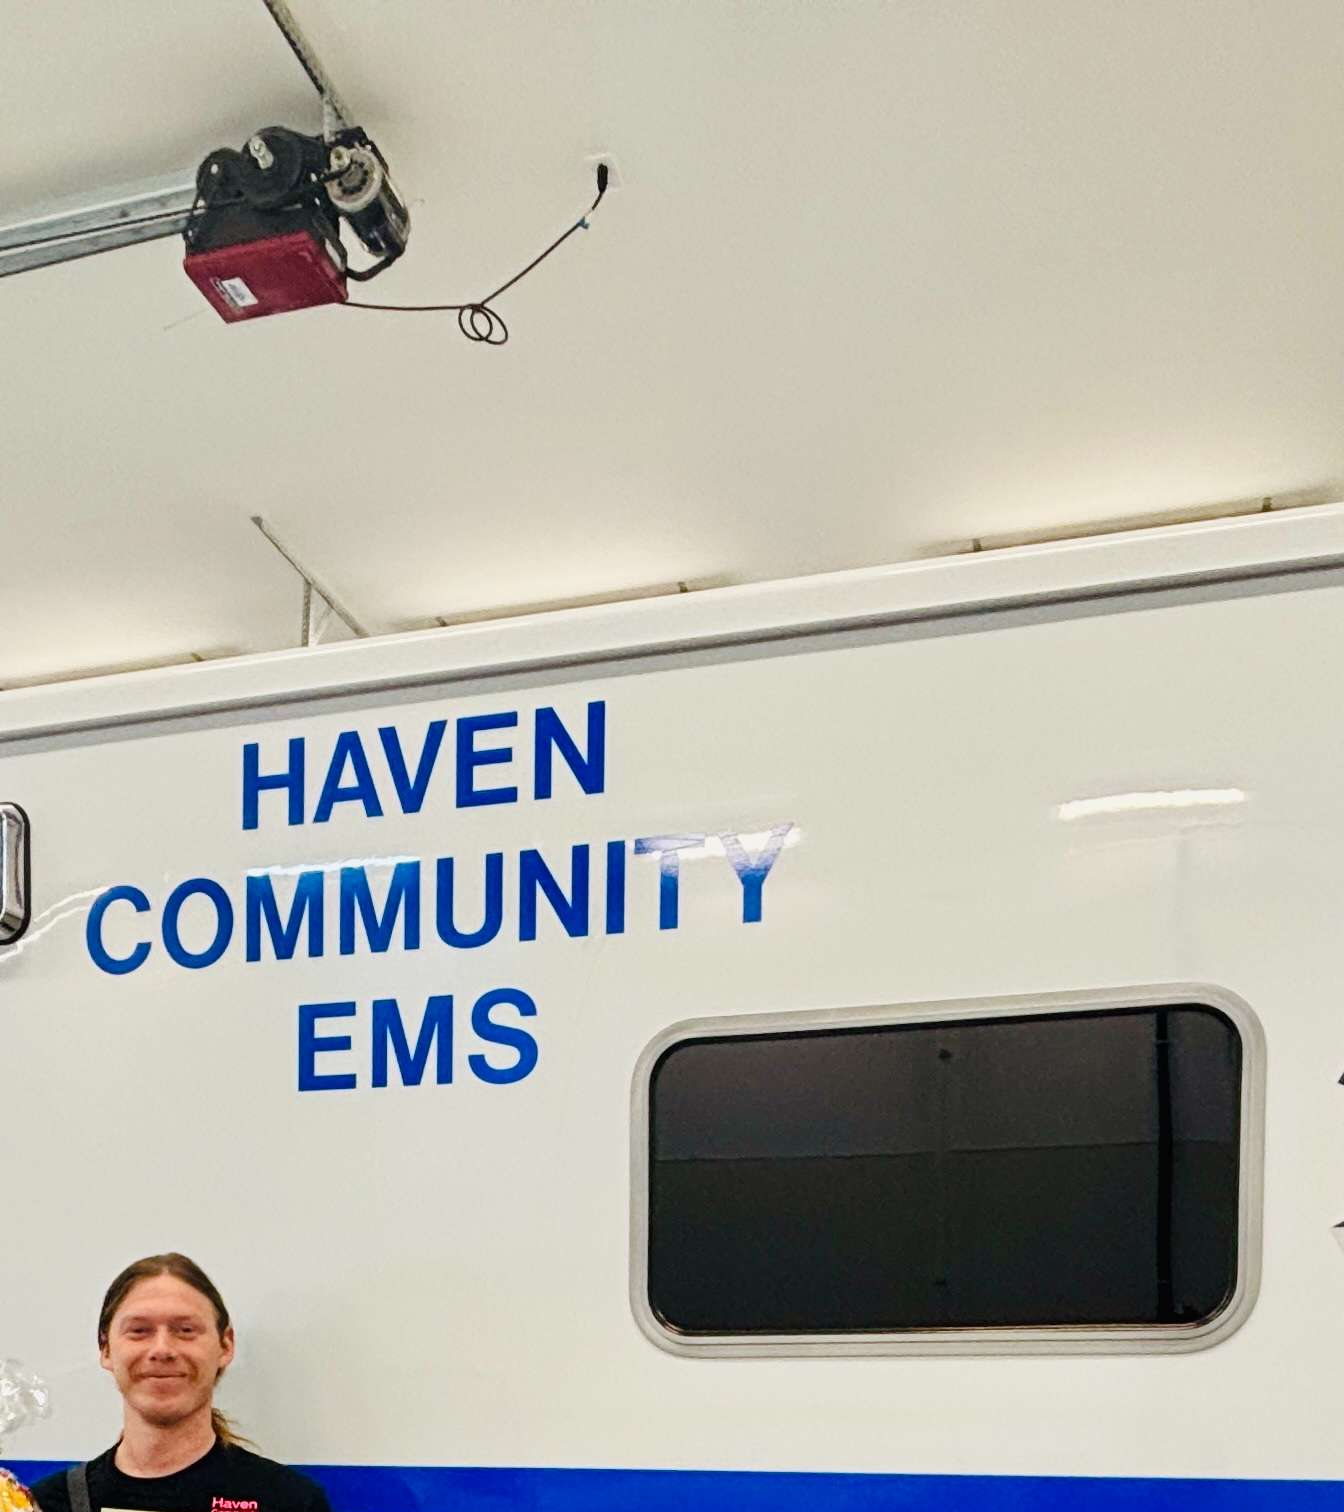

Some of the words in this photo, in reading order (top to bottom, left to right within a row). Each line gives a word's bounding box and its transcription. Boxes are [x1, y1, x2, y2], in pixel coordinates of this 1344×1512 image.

[242, 700, 607, 830] HAVEN
[86, 822, 795, 975] COMMUNITY
[298, 988, 539, 1092] EMS
[212, 1496, 258, 1510] Haven
